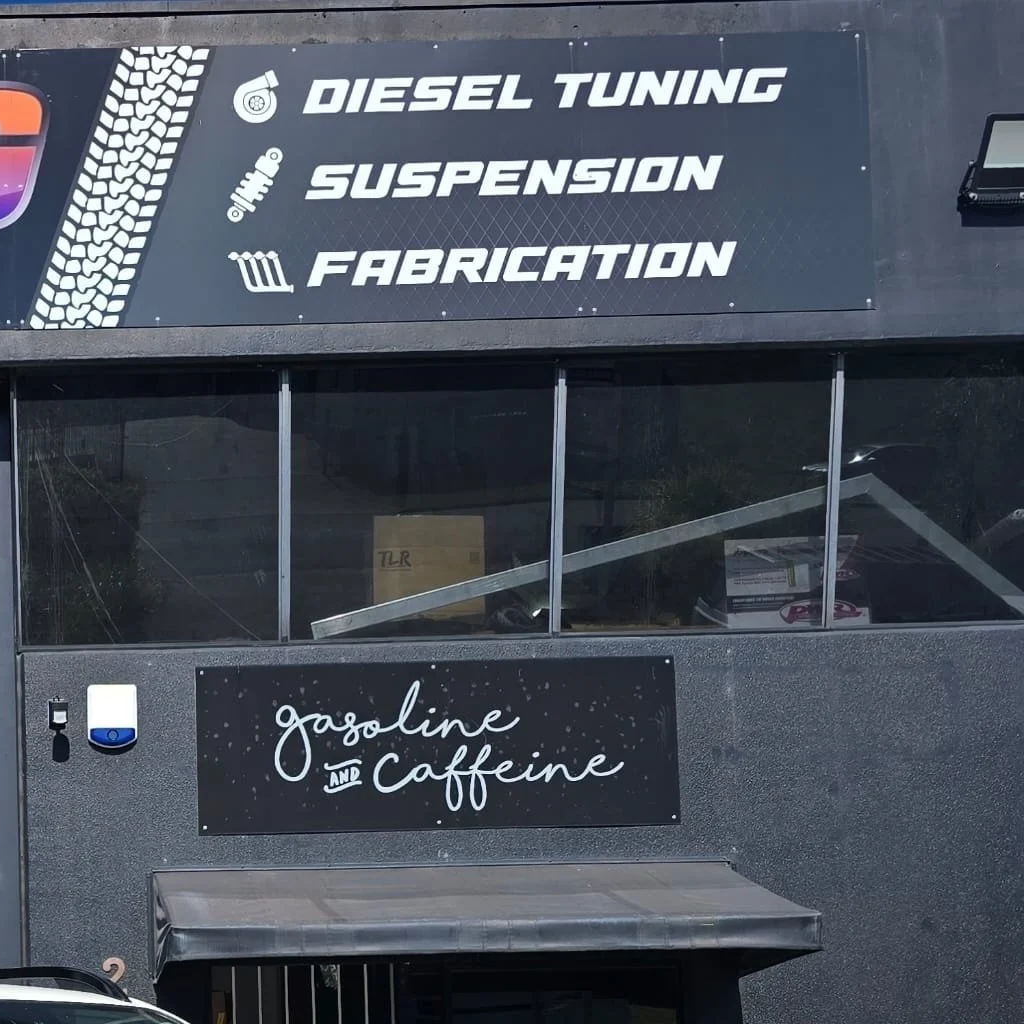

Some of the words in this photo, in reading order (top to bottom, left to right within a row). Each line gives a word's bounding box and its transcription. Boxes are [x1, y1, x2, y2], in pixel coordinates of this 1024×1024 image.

[303, 74, 533, 114] DIESEL
[554, 67, 787, 109] TUNING
[305, 155, 724, 200] SUSPENSION
[307, 241, 738, 287] FABRICATION
[378, 550, 411, 568] TLR
[275, 680, 520, 782] gasoline
[328, 764, 361, 788] AND
